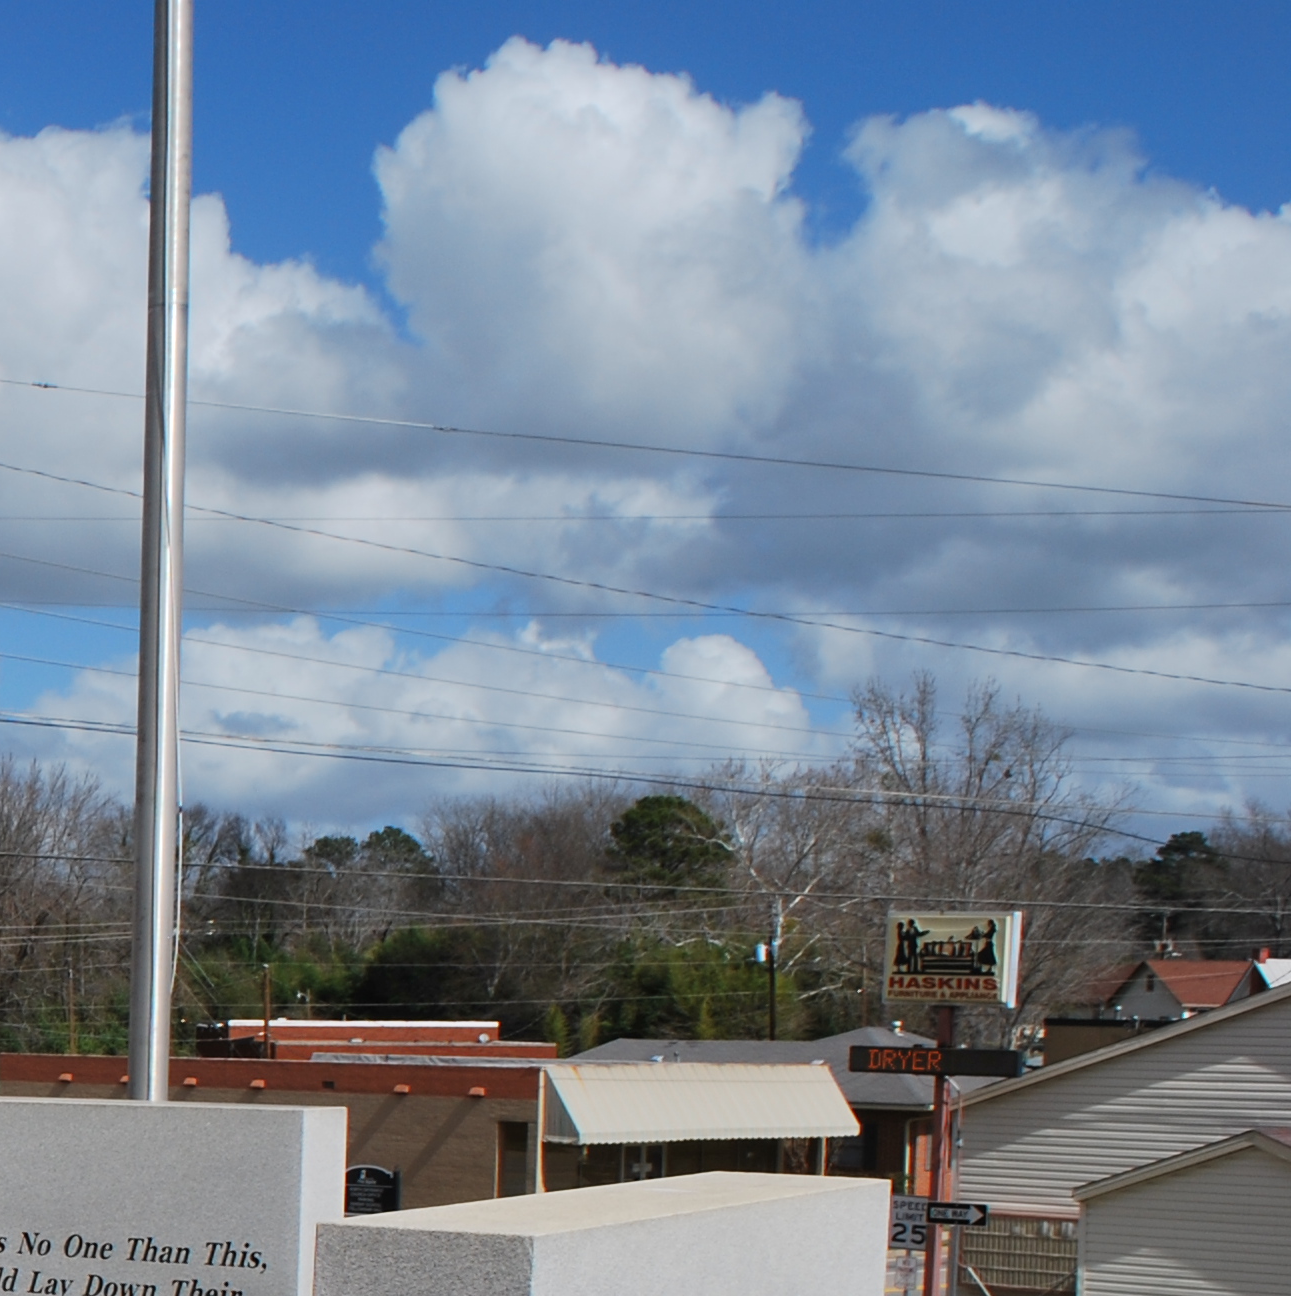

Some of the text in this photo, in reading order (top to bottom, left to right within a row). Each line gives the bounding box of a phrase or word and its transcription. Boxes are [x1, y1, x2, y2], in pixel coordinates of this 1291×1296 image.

[889, 976, 998, 990] HASKINS
[888, 990, 937, 998] FURNITURE
[949, 991, 998, 999] APPLIANCE
[868, 1049, 942, 1071] DRYER
[895, 1212, 923, 1222] LIMIT
[933, 1209, 968, 1218] ONE WAY
[891, 1222, 926, 1244] 25
[17, 1232, 51, 1256] No
[64, 1234, 113, 1260] One
[126, 1237, 190, 1264] Than
[205, 1241, 267, 1274] This,
